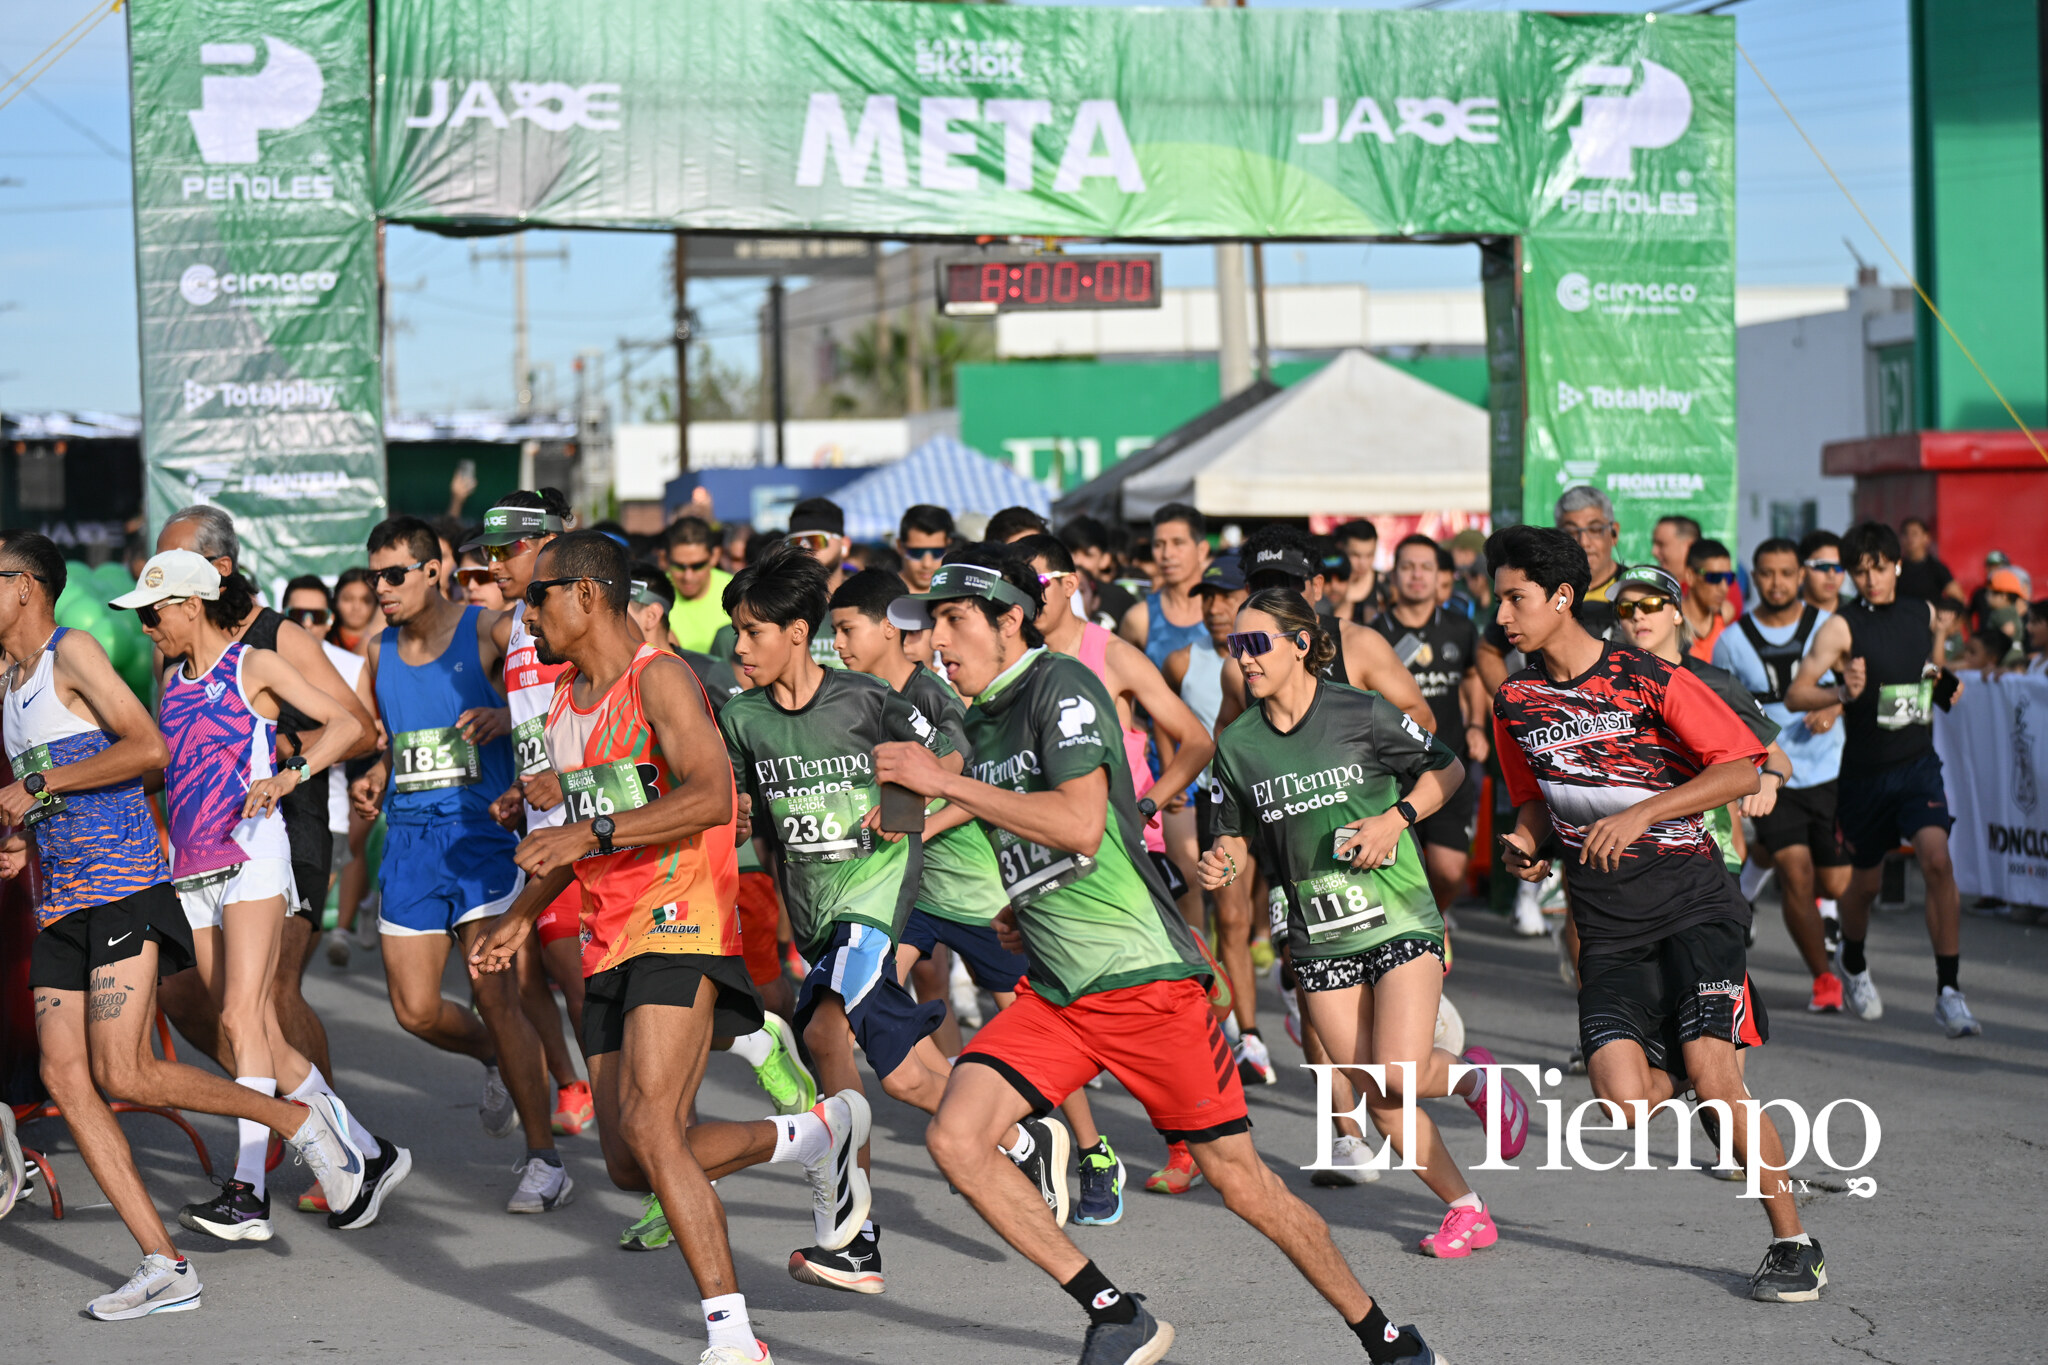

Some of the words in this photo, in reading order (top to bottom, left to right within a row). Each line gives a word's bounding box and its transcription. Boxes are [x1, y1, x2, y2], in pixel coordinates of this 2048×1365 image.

[795, 92, 1146, 193] META
[220, 271, 340, 294] cimaco
[1592, 282, 1698, 303] cimaco
[219, 379, 337, 411] Totalplay
[1586, 383, 1693, 415] Totalplay
[241, 470, 351, 492] FRONTERA
[1606, 472, 1705, 492] FRONTERA
[1256, 549, 1283, 563] RUN
[519, 669, 539, 687] CLUB
[1528, 711, 1633, 750] IRONCAST
[402, 744, 454, 773] 185
[518, 733, 546, 768] 22
[566, 769, 594, 780] CARRERA
[618, 762, 634, 772] 146
[755, 759, 780, 785] El
[778, 752, 870, 781] Tiempo
[978, 749, 1038, 785] Tiempo
[787, 780, 853, 798] todos
[787, 795, 825, 805] CARRERA
[854, 793, 868, 801] 236
[1250, 779, 1276, 808] El
[1275, 763, 1363, 799] Tiempo
[567, 787, 615, 823] 146
[1261, 809, 1284, 824] de
[1284, 790, 1349, 816] todos
[783, 812, 843, 844] 236
[1000, 841, 1052, 884] 314
[1310, 885, 1369, 922] 118
